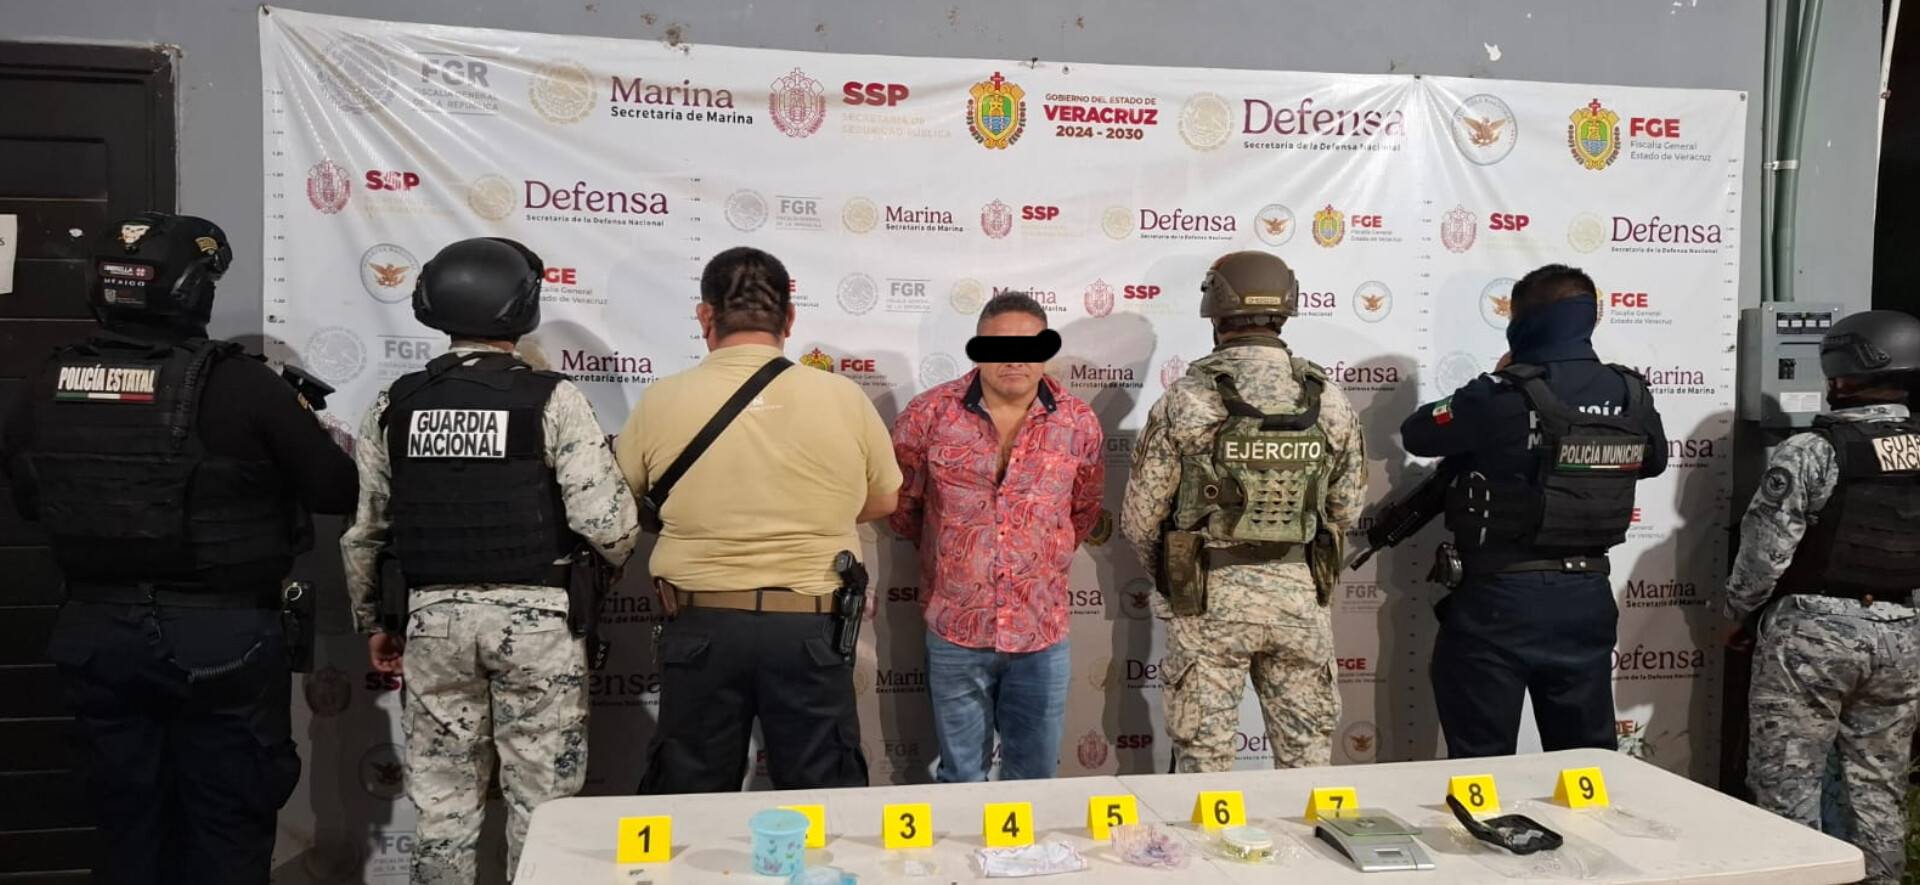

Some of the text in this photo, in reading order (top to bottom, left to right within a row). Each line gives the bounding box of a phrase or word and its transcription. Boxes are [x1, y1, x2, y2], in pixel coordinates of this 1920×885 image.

[421, 59, 489, 88] FGR
[610, 76, 734, 109] Marina
[843, 81, 909, 107] SSP
[1045, 93, 1090, 103] GOBIERNO
[1091, 96, 1108, 104] DEL
[1110, 96, 1143, 105] ESTADO
[686, 109, 703, 121] de
[706, 111, 753, 125] Marina
[1044, 105, 1158, 125] VERACRUZ
[1242, 98, 1405, 136] Defensa
[1056, 125, 1093, 138] 2024
[1106, 127, 1144, 140] 2030
[1630, 117, 1680, 138] FGE
[1630, 151, 1660, 161] Estado
[1674, 153, 1712, 163] Veracruz
[365, 170, 420, 191] SSP
[524, 180, 669, 215] Defensa
[781, 199, 817, 215] FGR
[886, 206, 953, 224] Marina
[1021, 205, 1060, 221] SSP
[1140, 208, 1237, 232] Defensa
[1351, 215, 1382, 228] FGE
[1489, 212, 1529, 231] SSP
[1611, 216, 1721, 244] Defensa
[543, 267, 577, 285] GE
[891, 282, 926, 297] FGR
[1123, 284, 1161, 300] SSP
[1611, 292, 1648, 308] FGE
[385, 340, 431, 360] FGR
[561, 349, 652, 374] Marina
[841, 359, 875, 373] FGE
[1325, 360, 1399, 383] efensa
[58, 363, 155, 393] POLICÍA ESTATAL
[1071, 364, 1134, 380] Marina
[417, 411, 498, 433] GUARDIA
[410, 434, 503, 456] NACIONAL
[1107, 438, 1131, 451] GR
[1225, 439, 1321, 459] EJÉRCITO
[1559, 441, 1600, 464] POLICÍA
[1345, 585, 1377, 599] FGR
[1626, 579, 1696, 599] Marina
[1336, 658, 1366, 671] FGE
[366, 671, 401, 691] SS
[876, 668, 924, 686] Mari
[1117, 734, 1153, 749] SSP
[1468, 783, 1485, 807] 8
[1579, 775, 1595, 800] 9
[1106, 804, 1124, 827] 5
[1214, 799, 1231, 825] 6
[1329, 796, 1344, 818] 7
[899, 813, 917, 839] 3
[1002, 811, 1020, 838] 4
[381, 835, 416, 855] FG
[637, 825, 652, 853] 1
